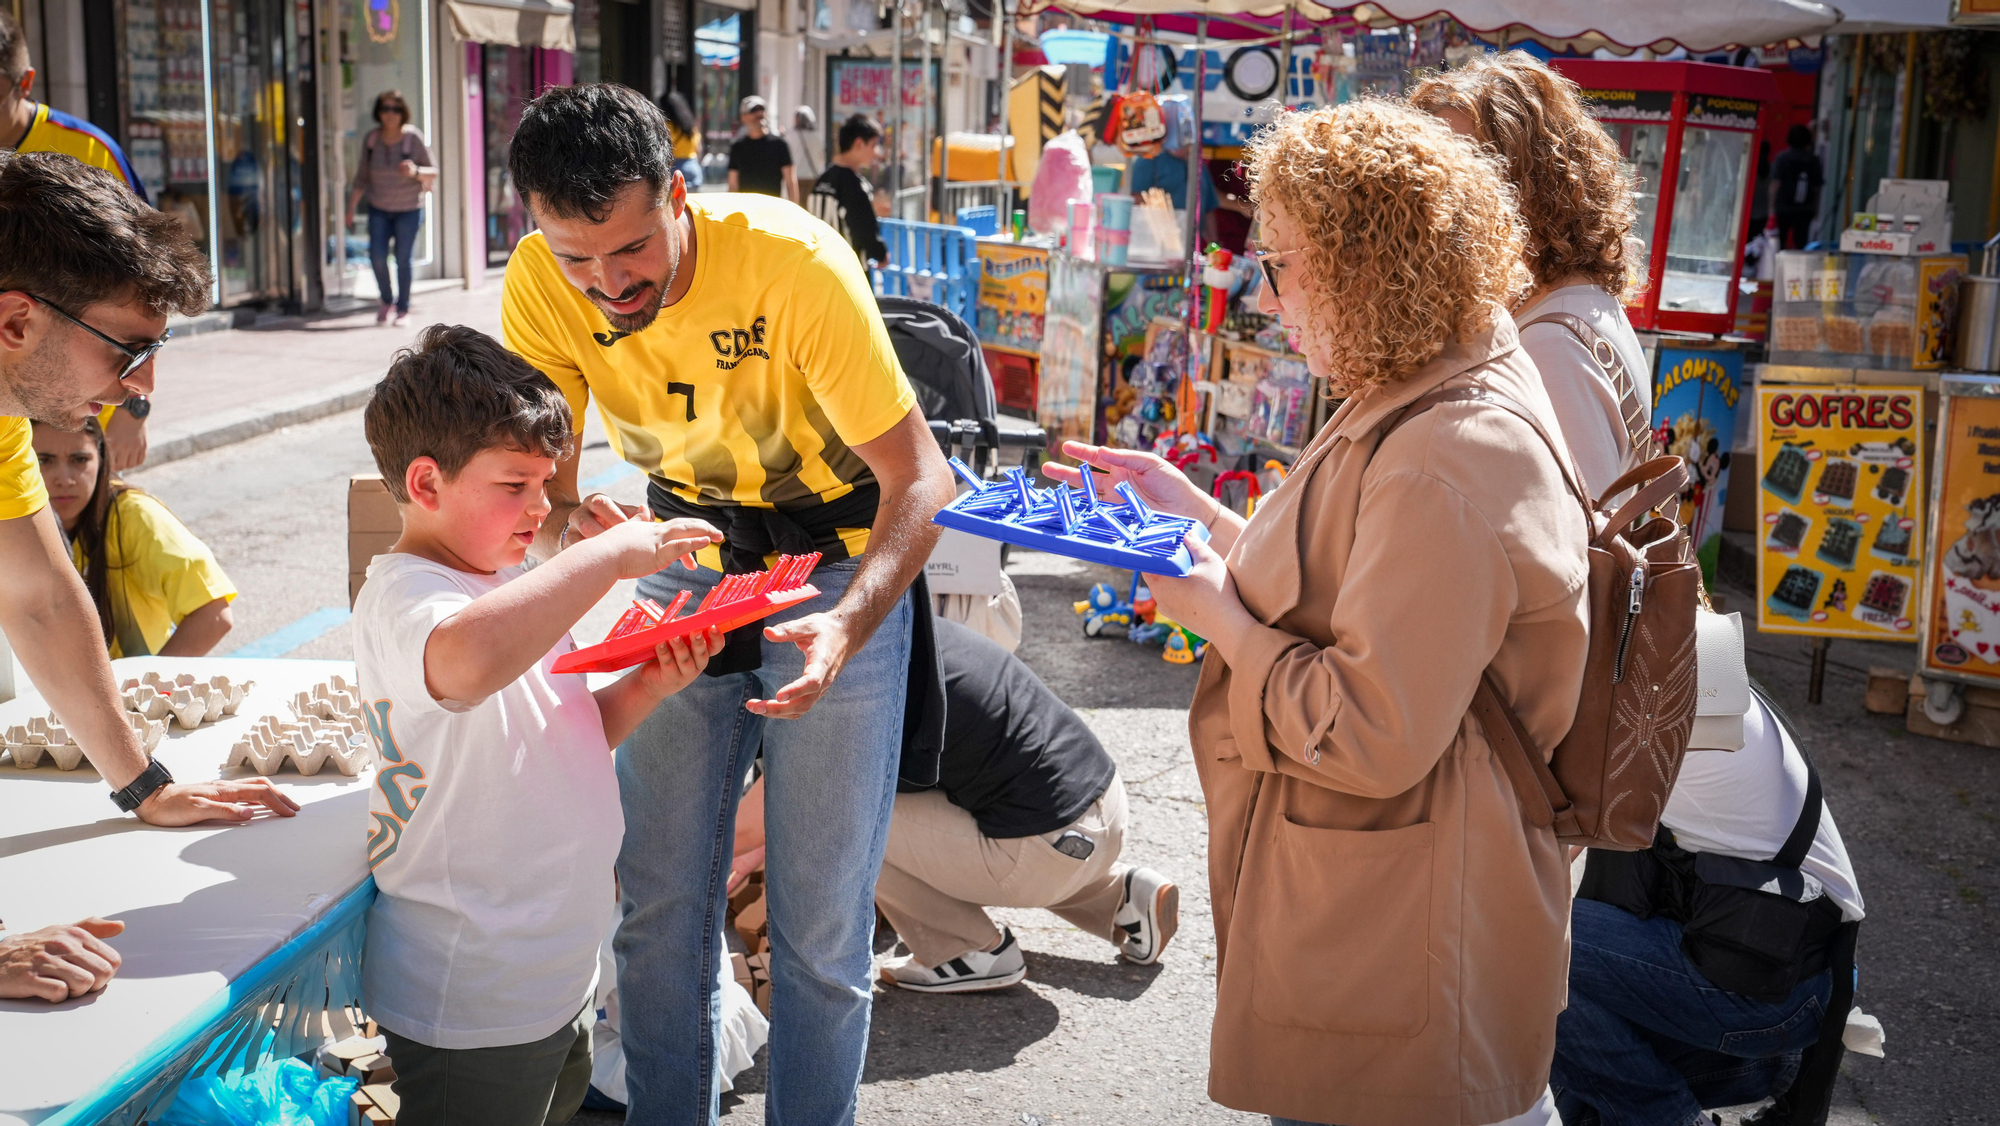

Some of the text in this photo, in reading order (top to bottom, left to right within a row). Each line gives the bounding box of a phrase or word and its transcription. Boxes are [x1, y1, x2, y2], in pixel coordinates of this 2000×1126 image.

[1707, 98, 1757, 111] POPCORN
[1855, 240, 1894, 251] nutella
[709, 315, 767, 358] CDF
[667, 381, 698, 423] 7
[1654, 358, 1739, 408] PALOMITAS
[1770, 394, 1913, 430] GOFRES
